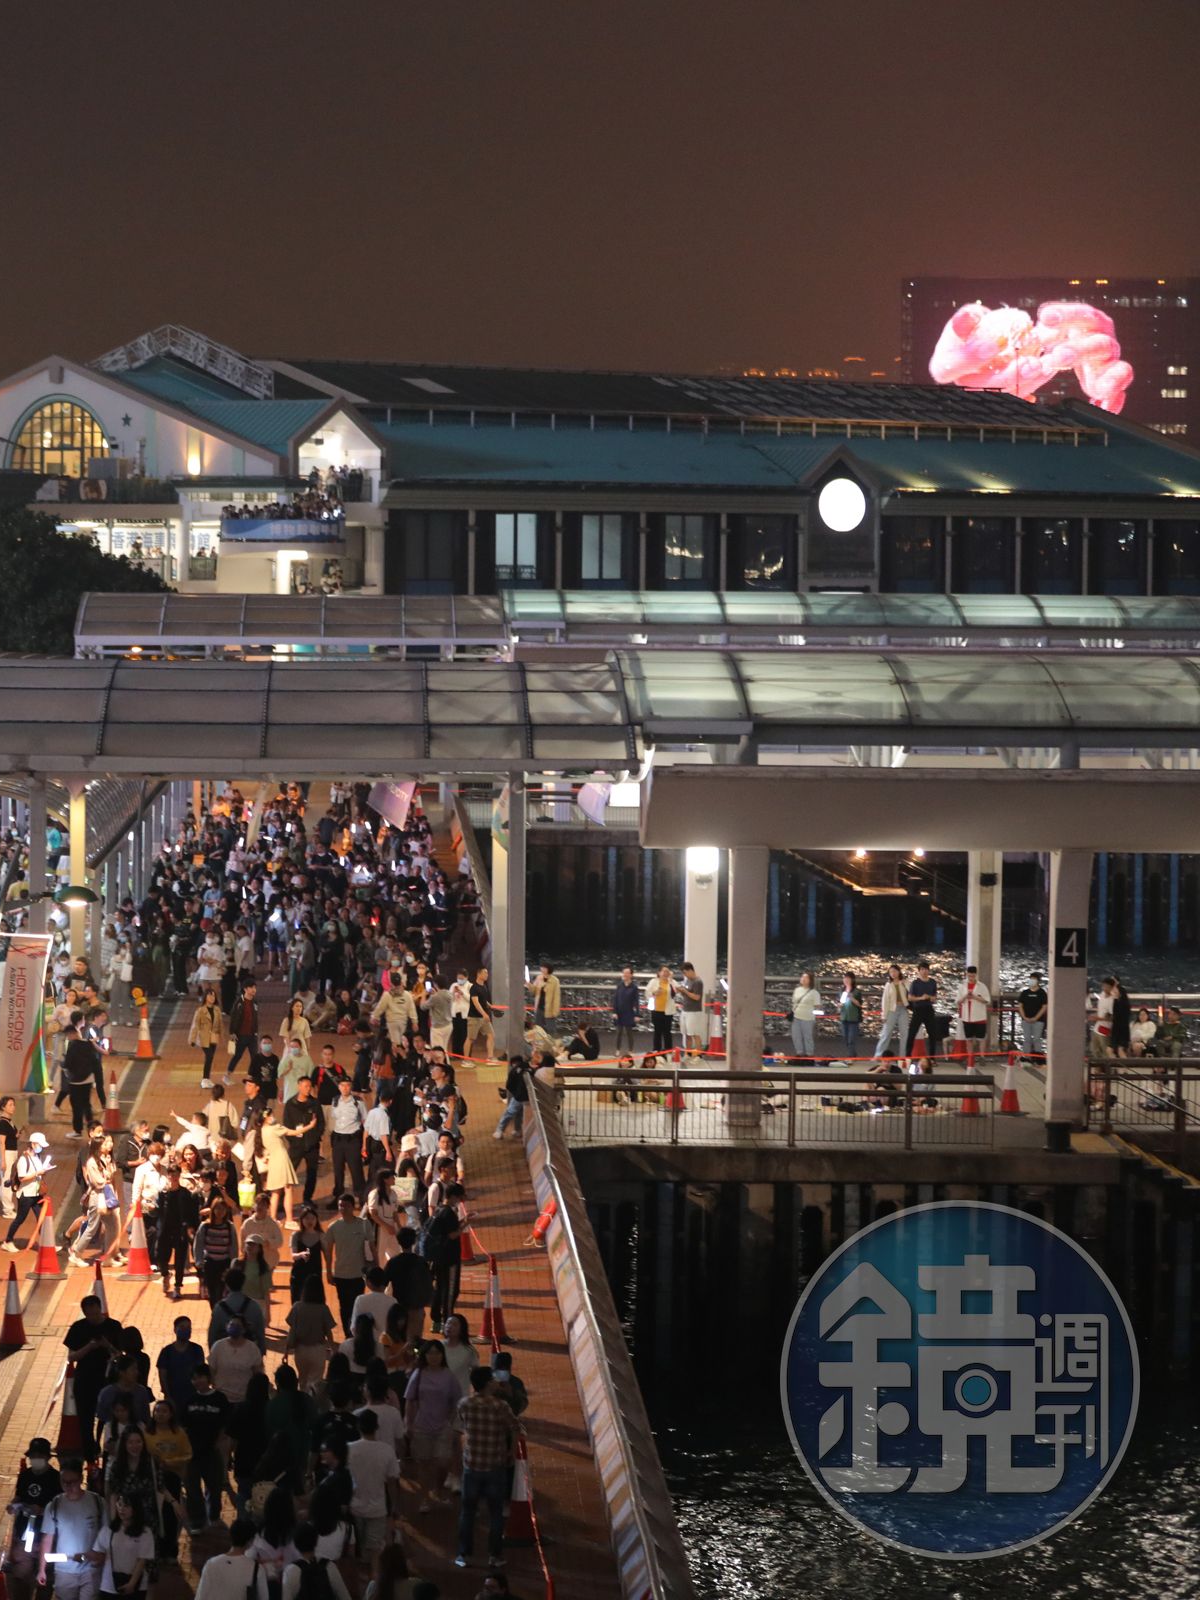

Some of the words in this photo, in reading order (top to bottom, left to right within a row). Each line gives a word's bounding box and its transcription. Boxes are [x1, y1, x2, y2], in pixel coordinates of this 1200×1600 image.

[1061, 931, 1079, 964] 4
[16, 967, 26, 1008] HONG
[13, 1010, 24, 1051] KONG
